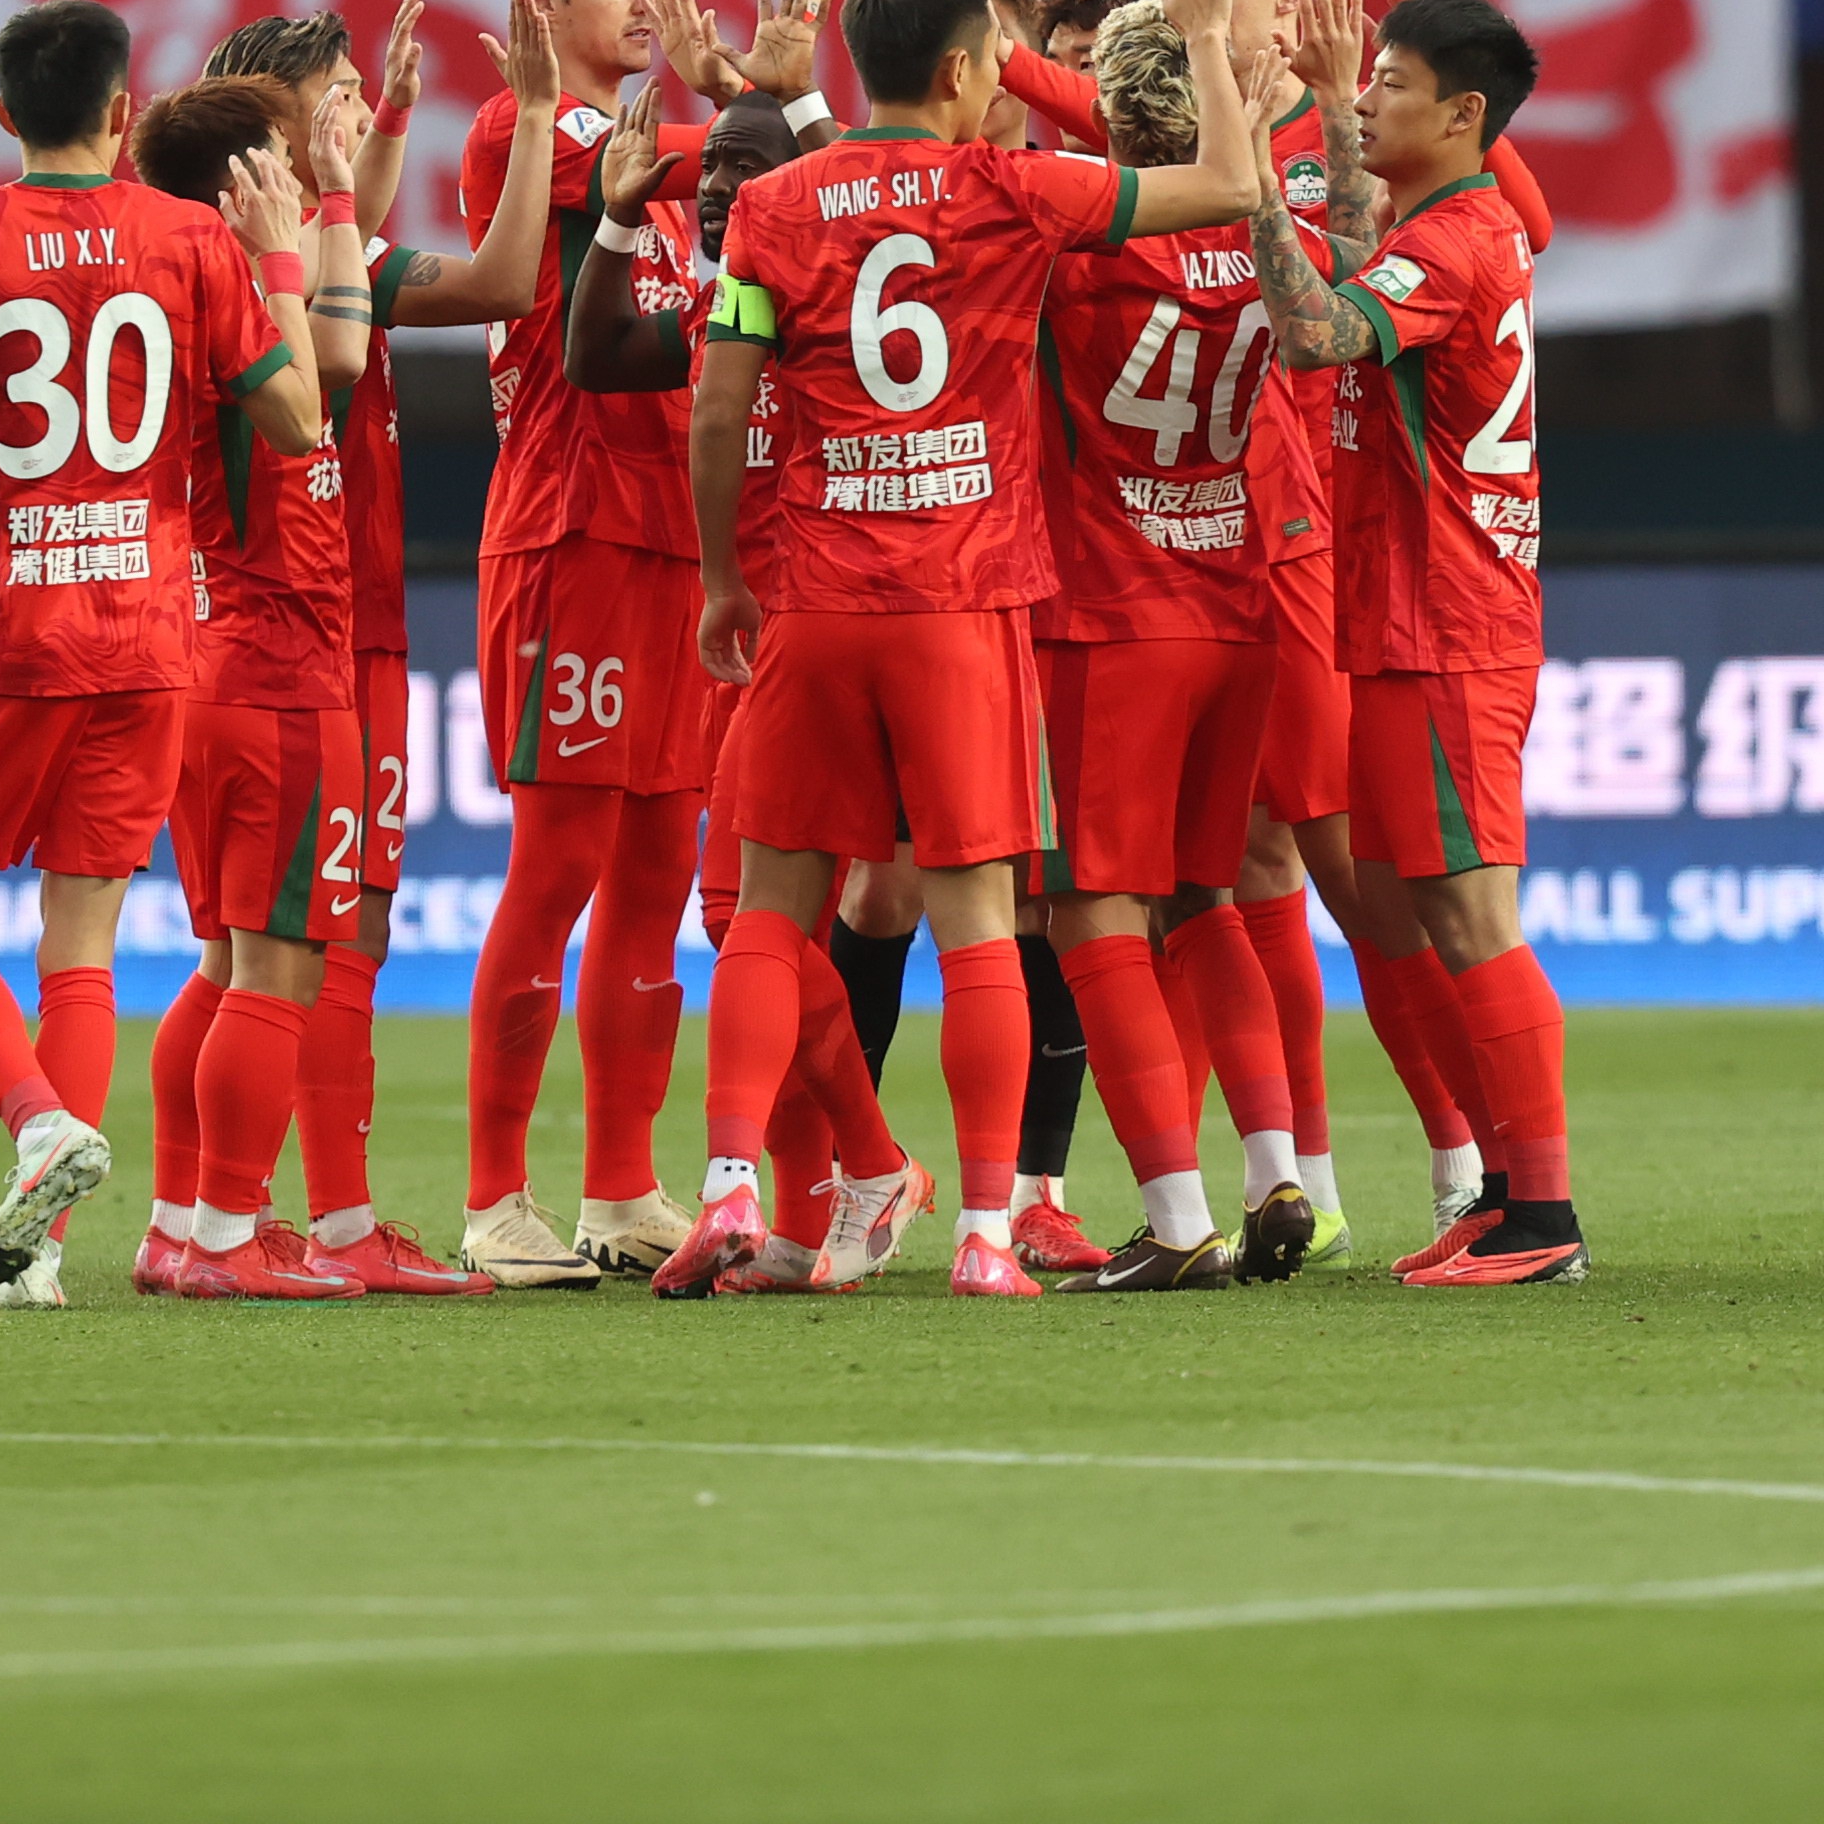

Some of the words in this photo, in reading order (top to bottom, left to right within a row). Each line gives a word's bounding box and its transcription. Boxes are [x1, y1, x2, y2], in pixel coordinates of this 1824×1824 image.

[816, 176, 880, 222] WANG
[25, 232, 65, 271] LIU
[74, 228, 126, 265] X.Y.
[850, 233, 949, 412] 6
[1102, 294, 1276, 467] 40
[1463, 298, 1536, 474] 2
[821, 420, 988, 473] 郑发集团
[8, 499, 151, 545] 郑发集团
[548, 652, 624, 726] 36
